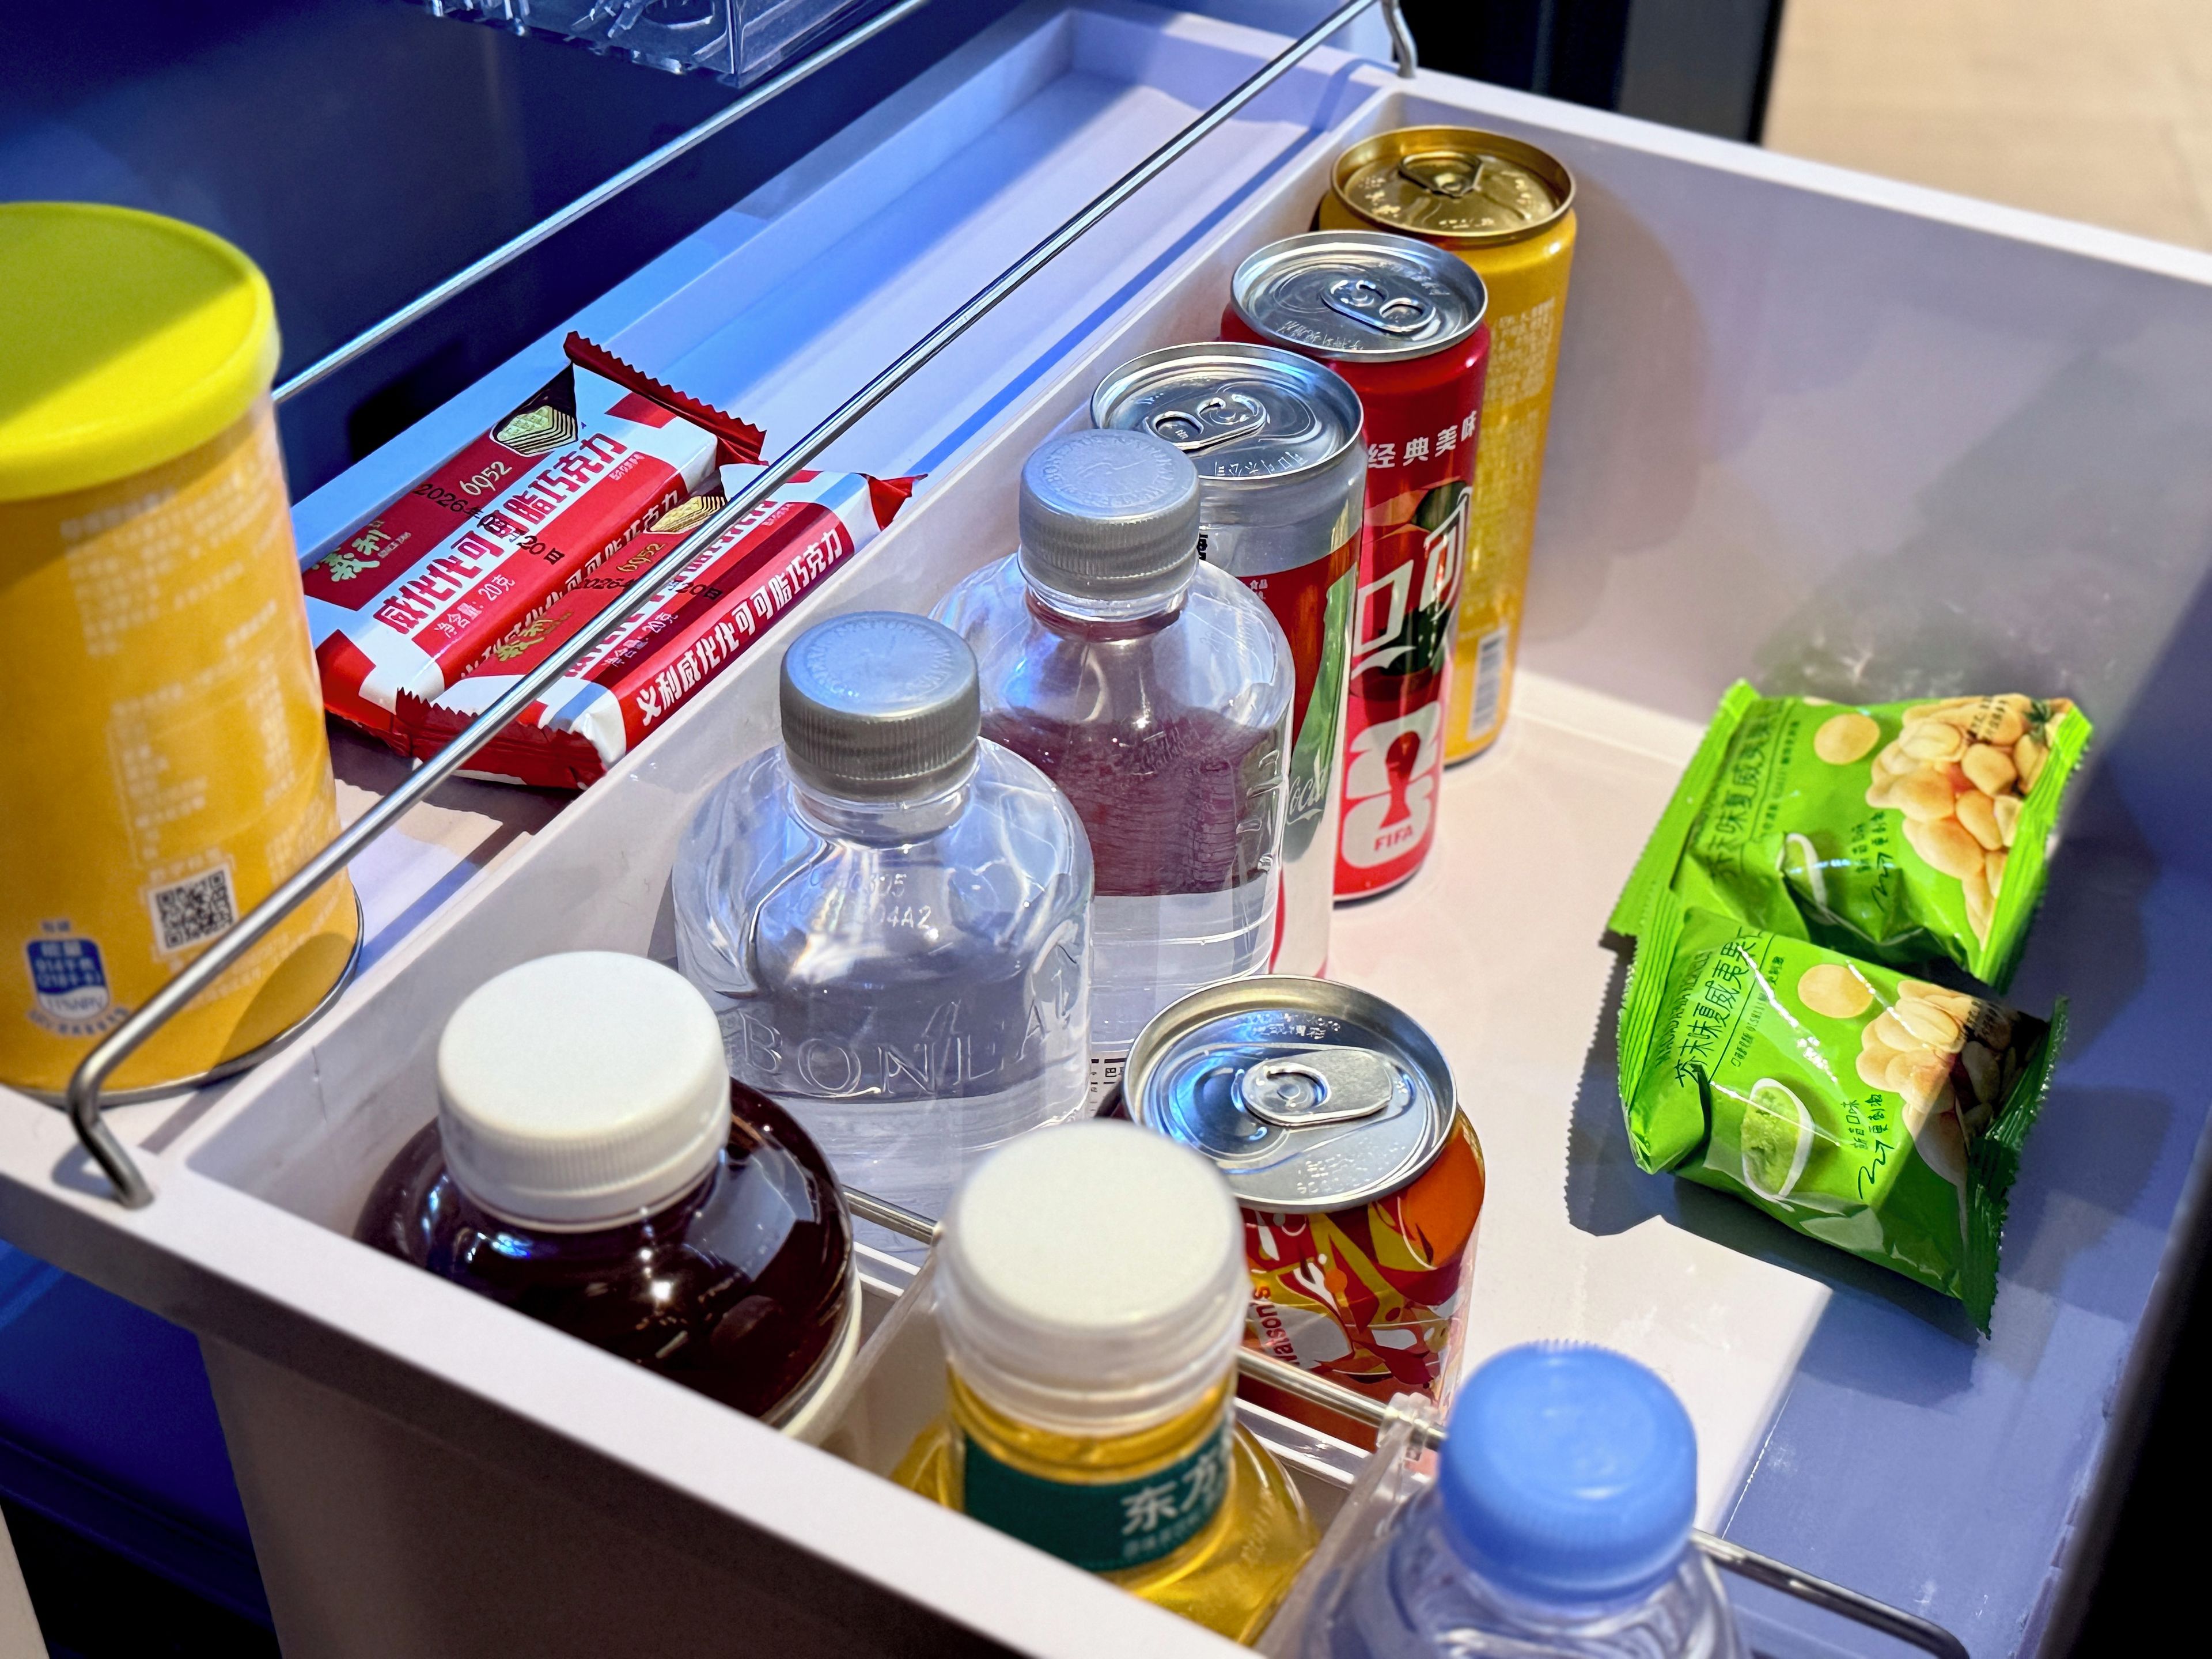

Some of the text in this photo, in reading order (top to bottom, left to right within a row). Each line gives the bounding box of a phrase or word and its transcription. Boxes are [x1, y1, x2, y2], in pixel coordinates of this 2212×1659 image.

[1367, 410, 1478, 469] 经典美味
[1373, 828, 1414, 853] FIFA
[1120, 1452, 1221, 1536] 东方
